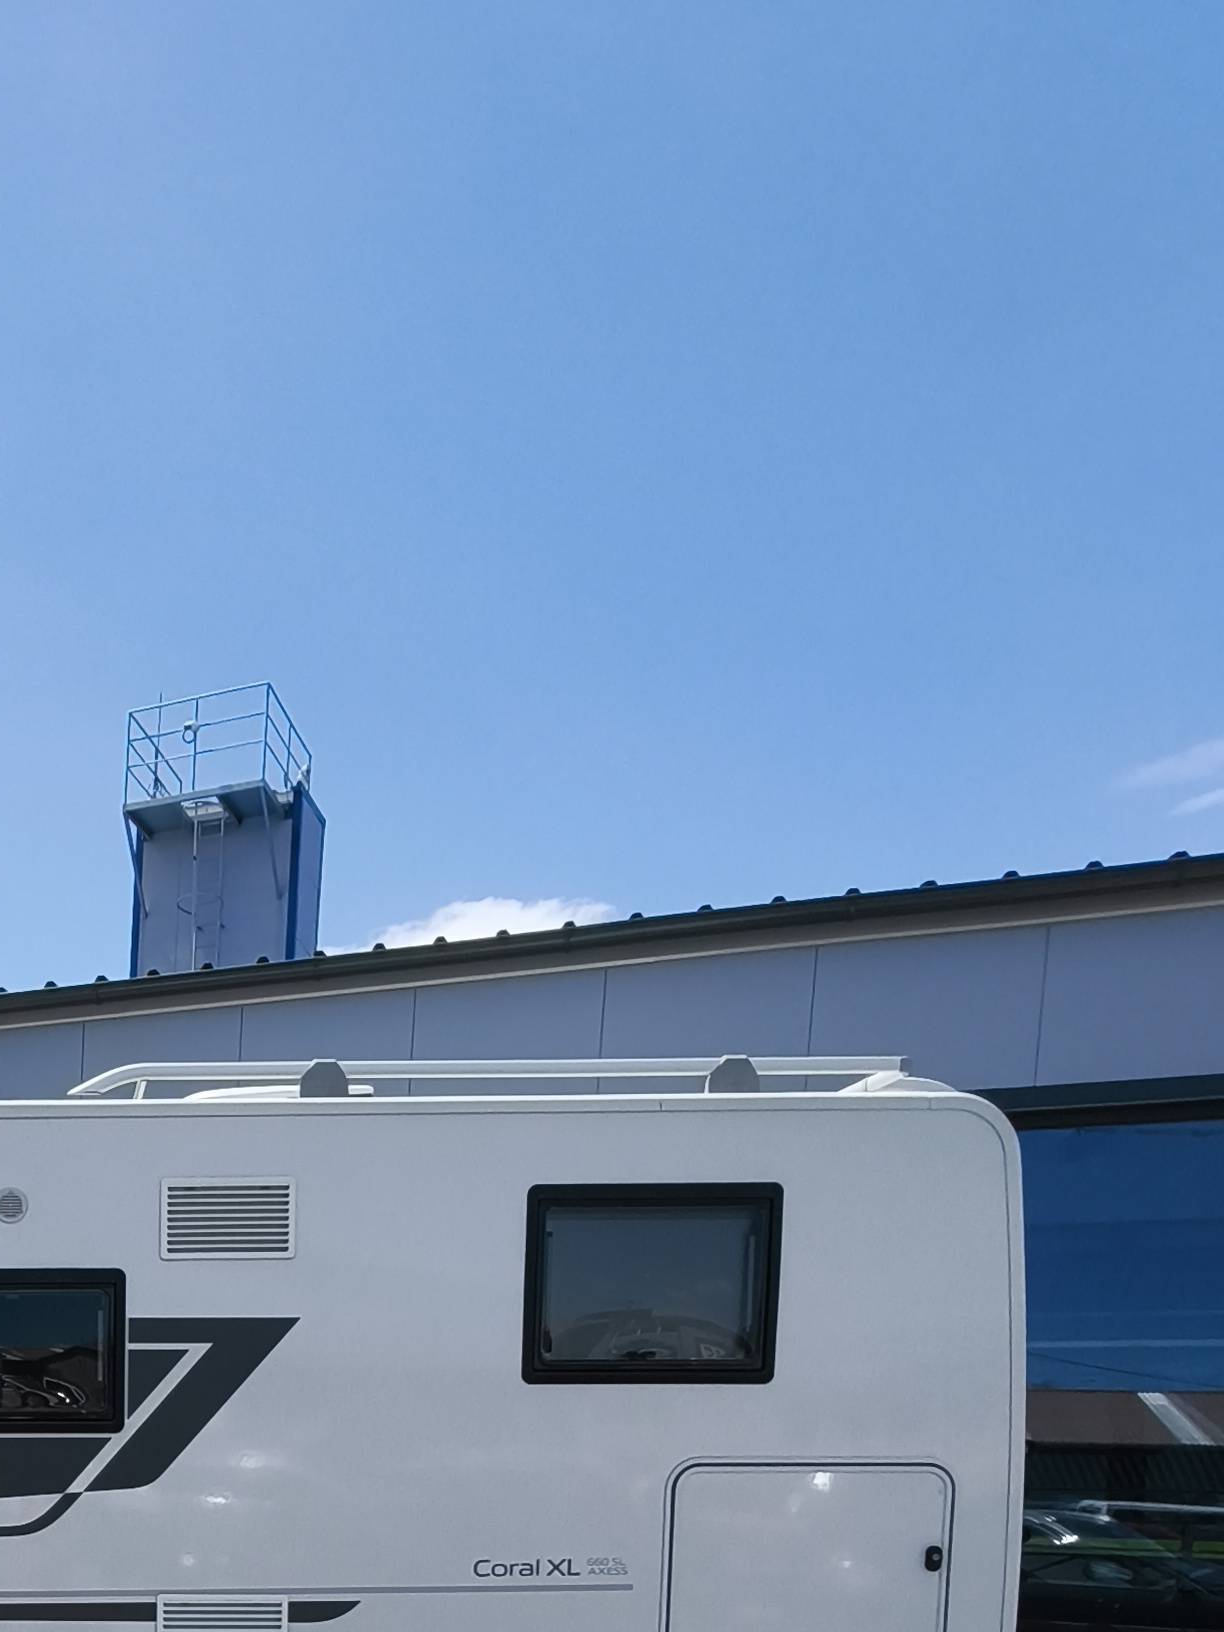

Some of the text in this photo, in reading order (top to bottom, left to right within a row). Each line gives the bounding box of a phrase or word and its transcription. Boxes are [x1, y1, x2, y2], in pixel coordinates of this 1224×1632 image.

[473, 1558, 581, 1578] Coral XL
[587, 1567, 629, 1576] AXESS
